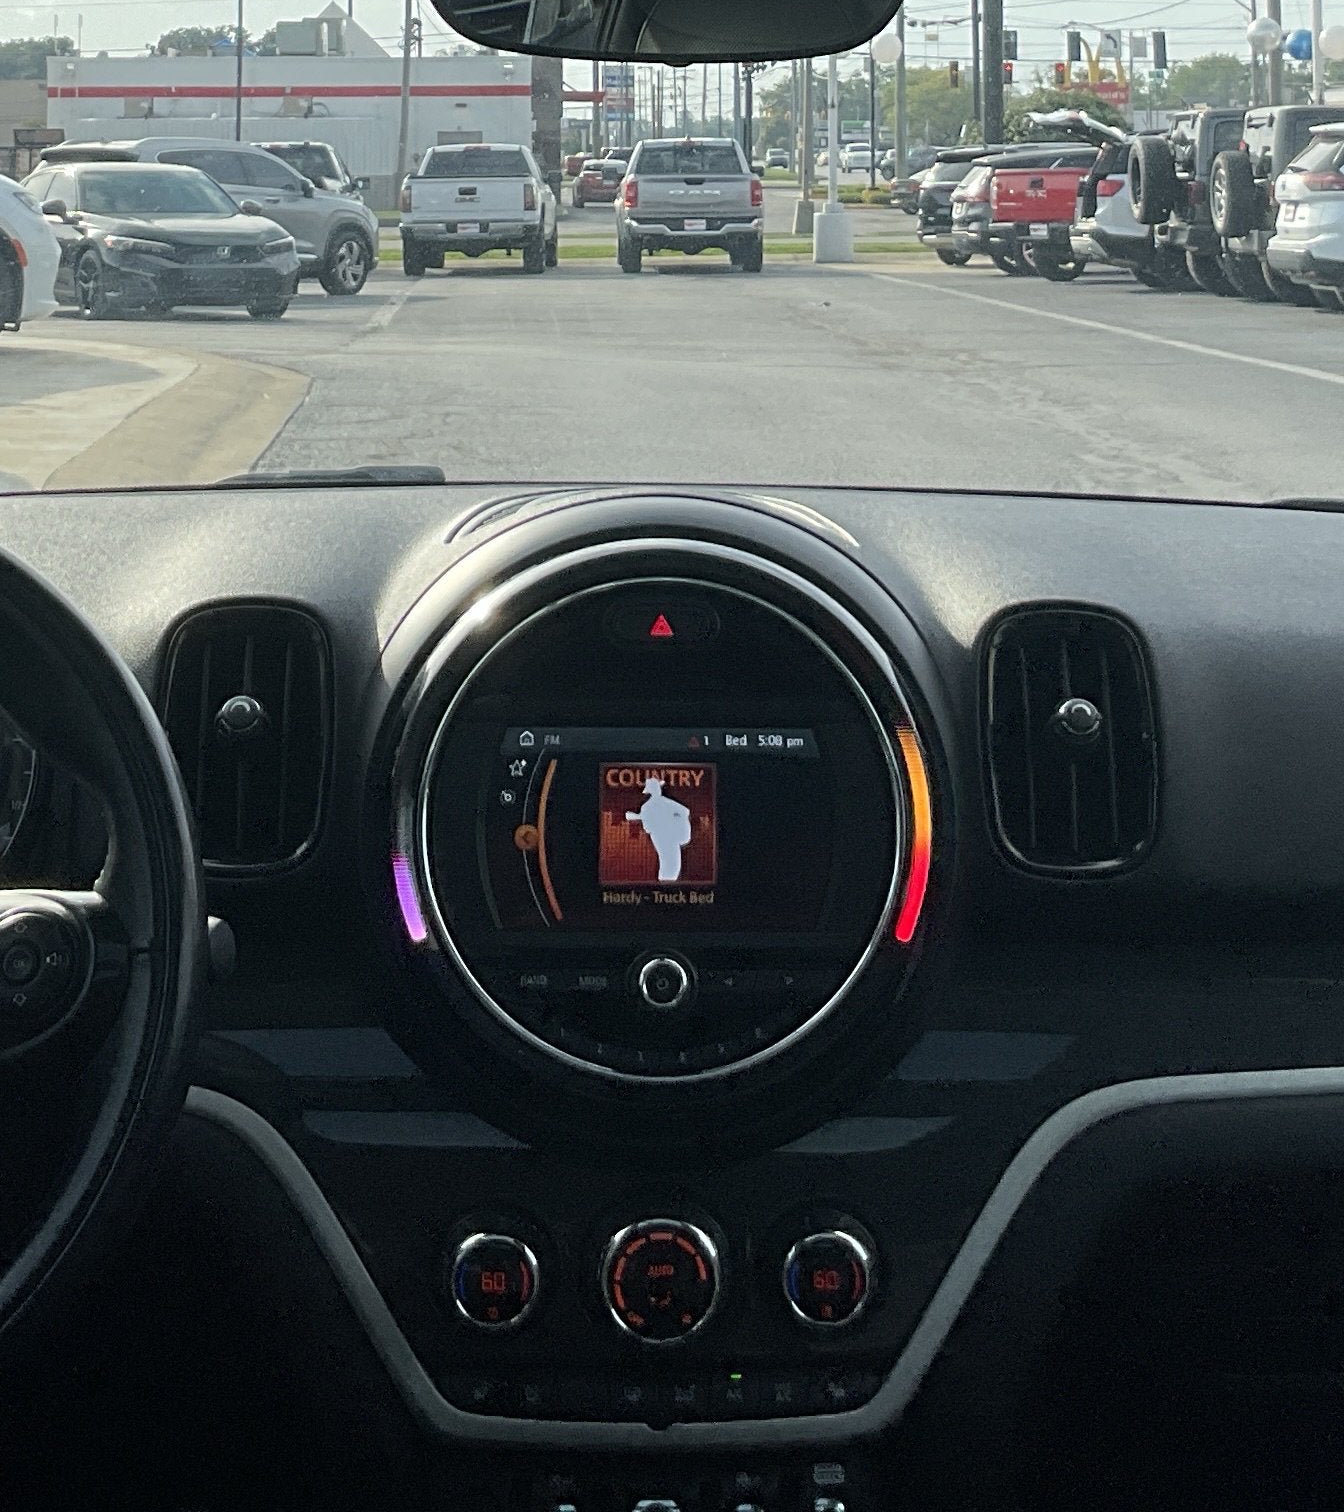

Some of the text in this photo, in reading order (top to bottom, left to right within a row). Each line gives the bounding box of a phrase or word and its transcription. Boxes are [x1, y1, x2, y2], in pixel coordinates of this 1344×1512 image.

[703, 730, 709, 746] 1
[725, 729, 748, 747] Bed
[786, 737, 804, 749] pm
[654, 890, 687, 904] Truck
[689, 890, 715, 904] Bed
[480, 1271, 506, 1294] 60
